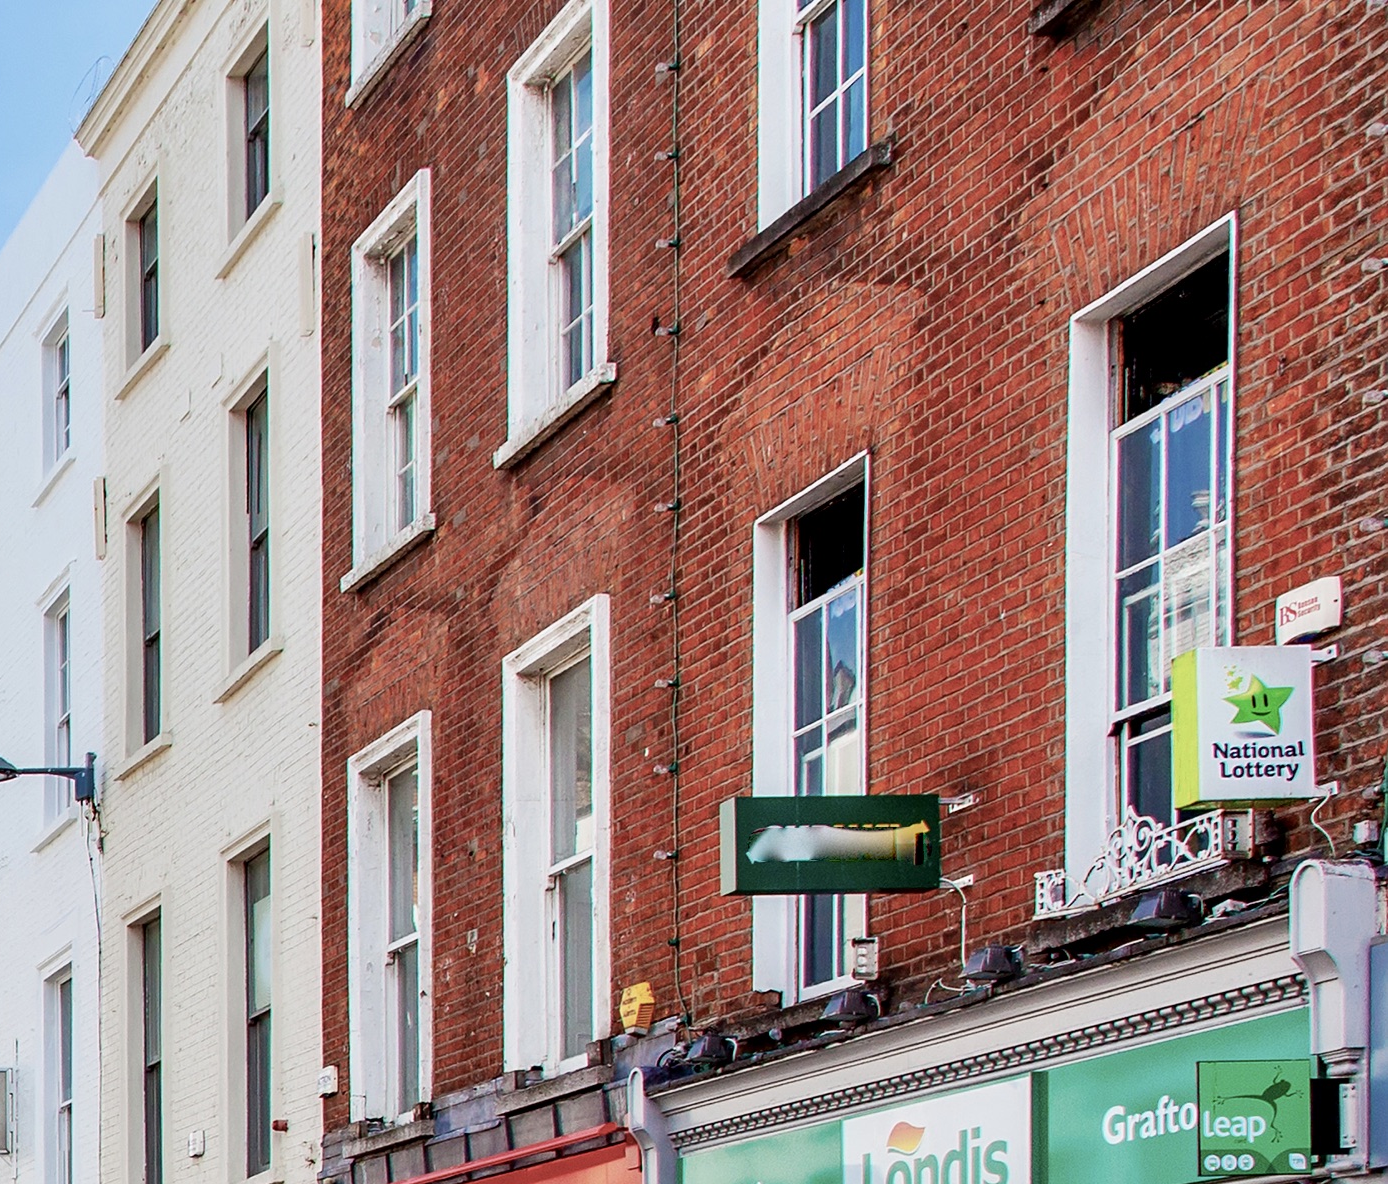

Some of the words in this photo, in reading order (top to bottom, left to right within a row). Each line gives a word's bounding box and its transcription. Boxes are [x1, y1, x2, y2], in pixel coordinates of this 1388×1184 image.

[1212, 740, 1305, 759] National
[1220, 762, 1299, 782] Lottery
[1203, 1110, 1267, 1143] leap
